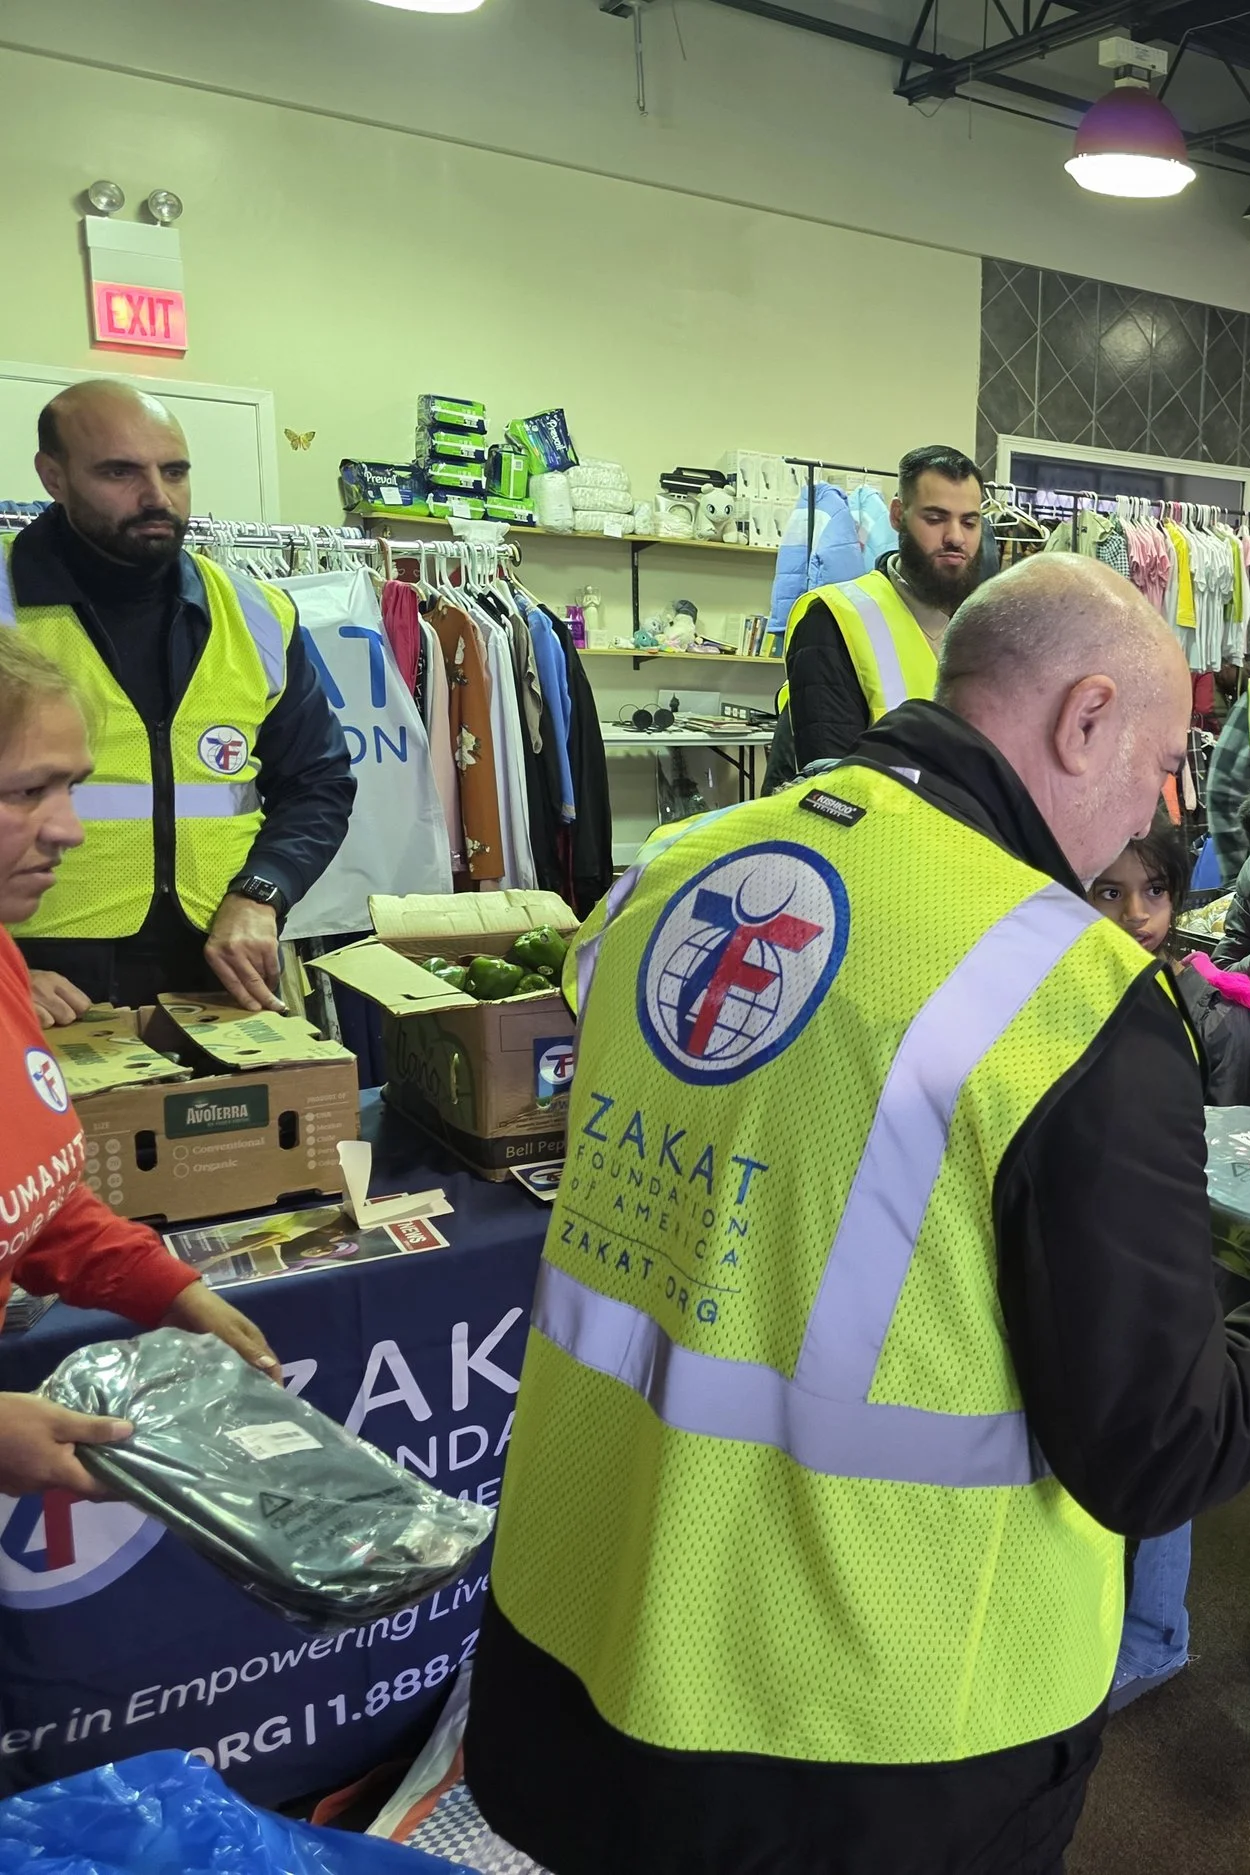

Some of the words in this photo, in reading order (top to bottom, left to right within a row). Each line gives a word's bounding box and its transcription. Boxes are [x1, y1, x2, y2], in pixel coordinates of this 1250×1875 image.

[106, 291, 174, 339] EXIT
[193, 1137, 265, 1154] Conventional
[506, 1142, 534, 1158] Bell
[582, 1092, 770, 1205] ZAKAT
[193, 1159, 238, 1173] Organic
[0, 1722, 57, 1754] er
[65, 1707, 112, 1743] in
[126, 1604, 420, 1725] Empowering
